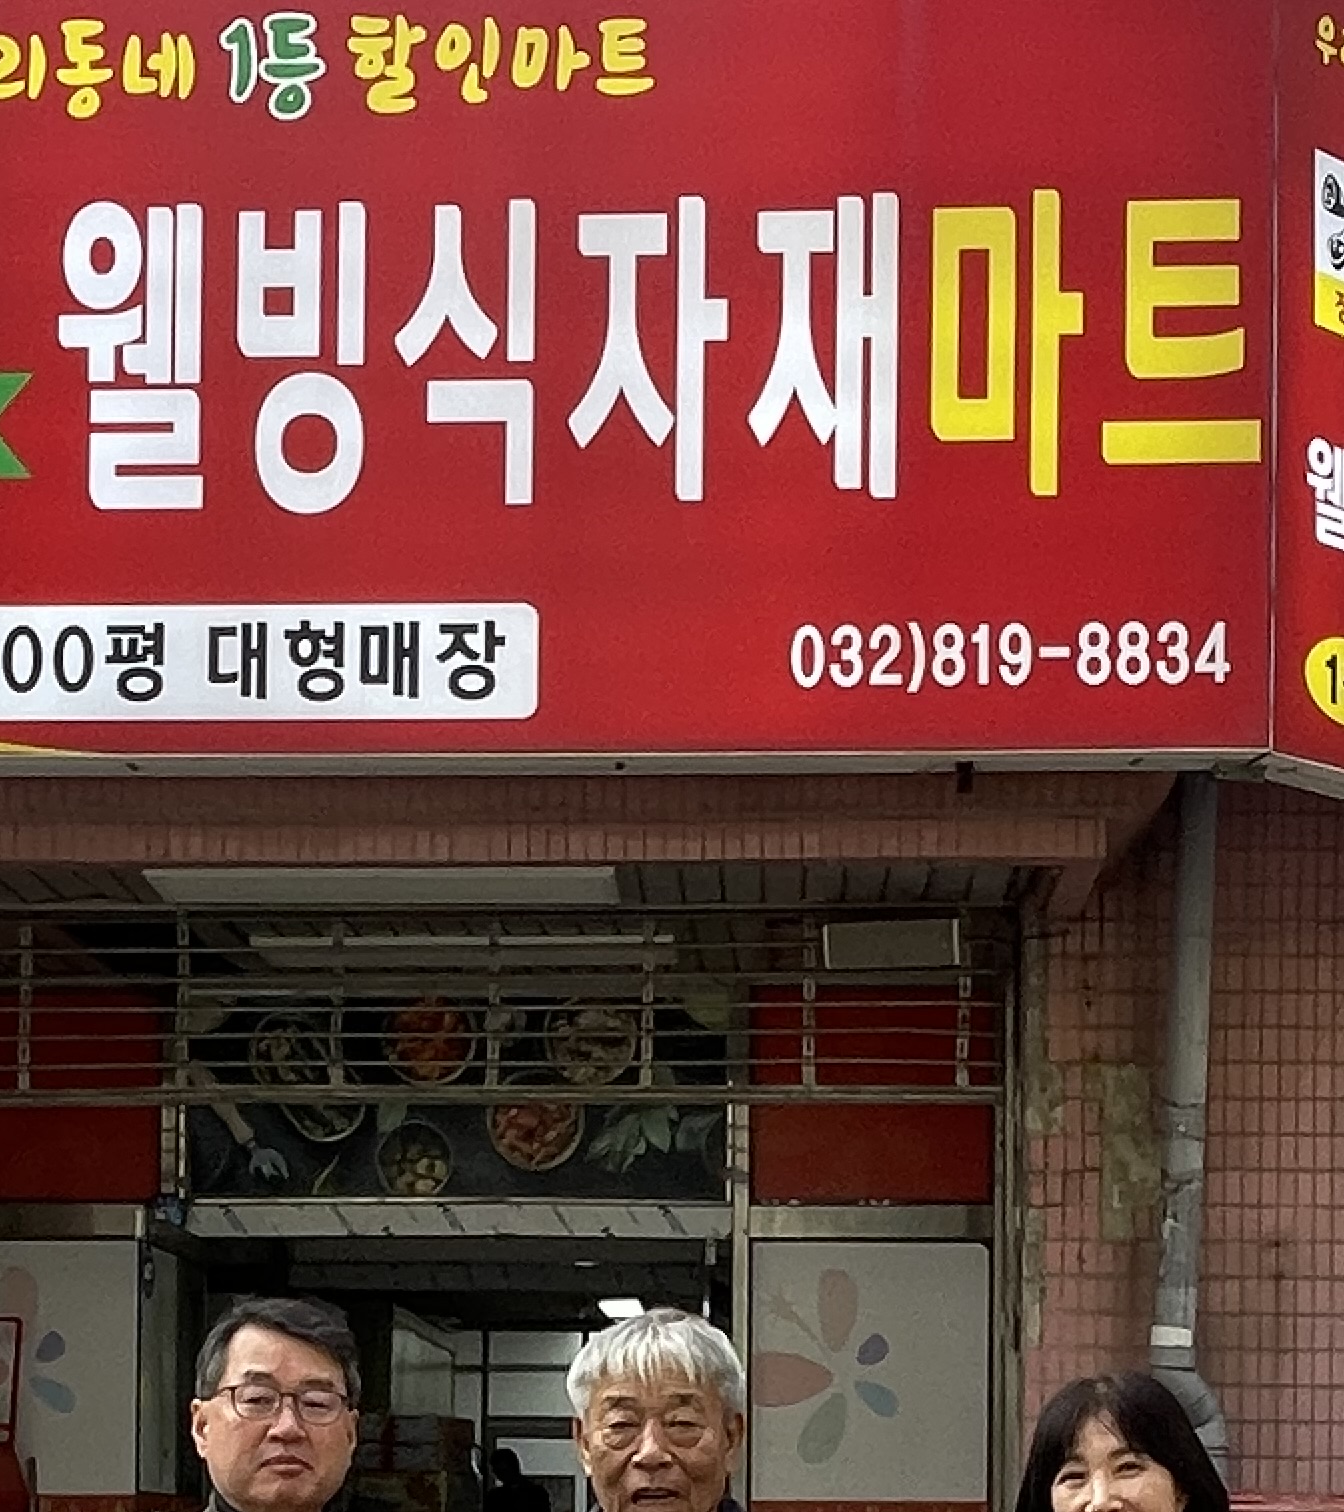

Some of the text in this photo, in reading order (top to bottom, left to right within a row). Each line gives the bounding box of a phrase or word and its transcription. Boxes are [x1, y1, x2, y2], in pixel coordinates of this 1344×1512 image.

[219, 12, 327, 121] 1등
[347, 14, 656, 116] 할인마트
[57, 189, 1262, 515] 웰빙식자재마트
[207, 619, 506, 702] 대형매장
[789, 619, 1231, 695] 032)819-8834
